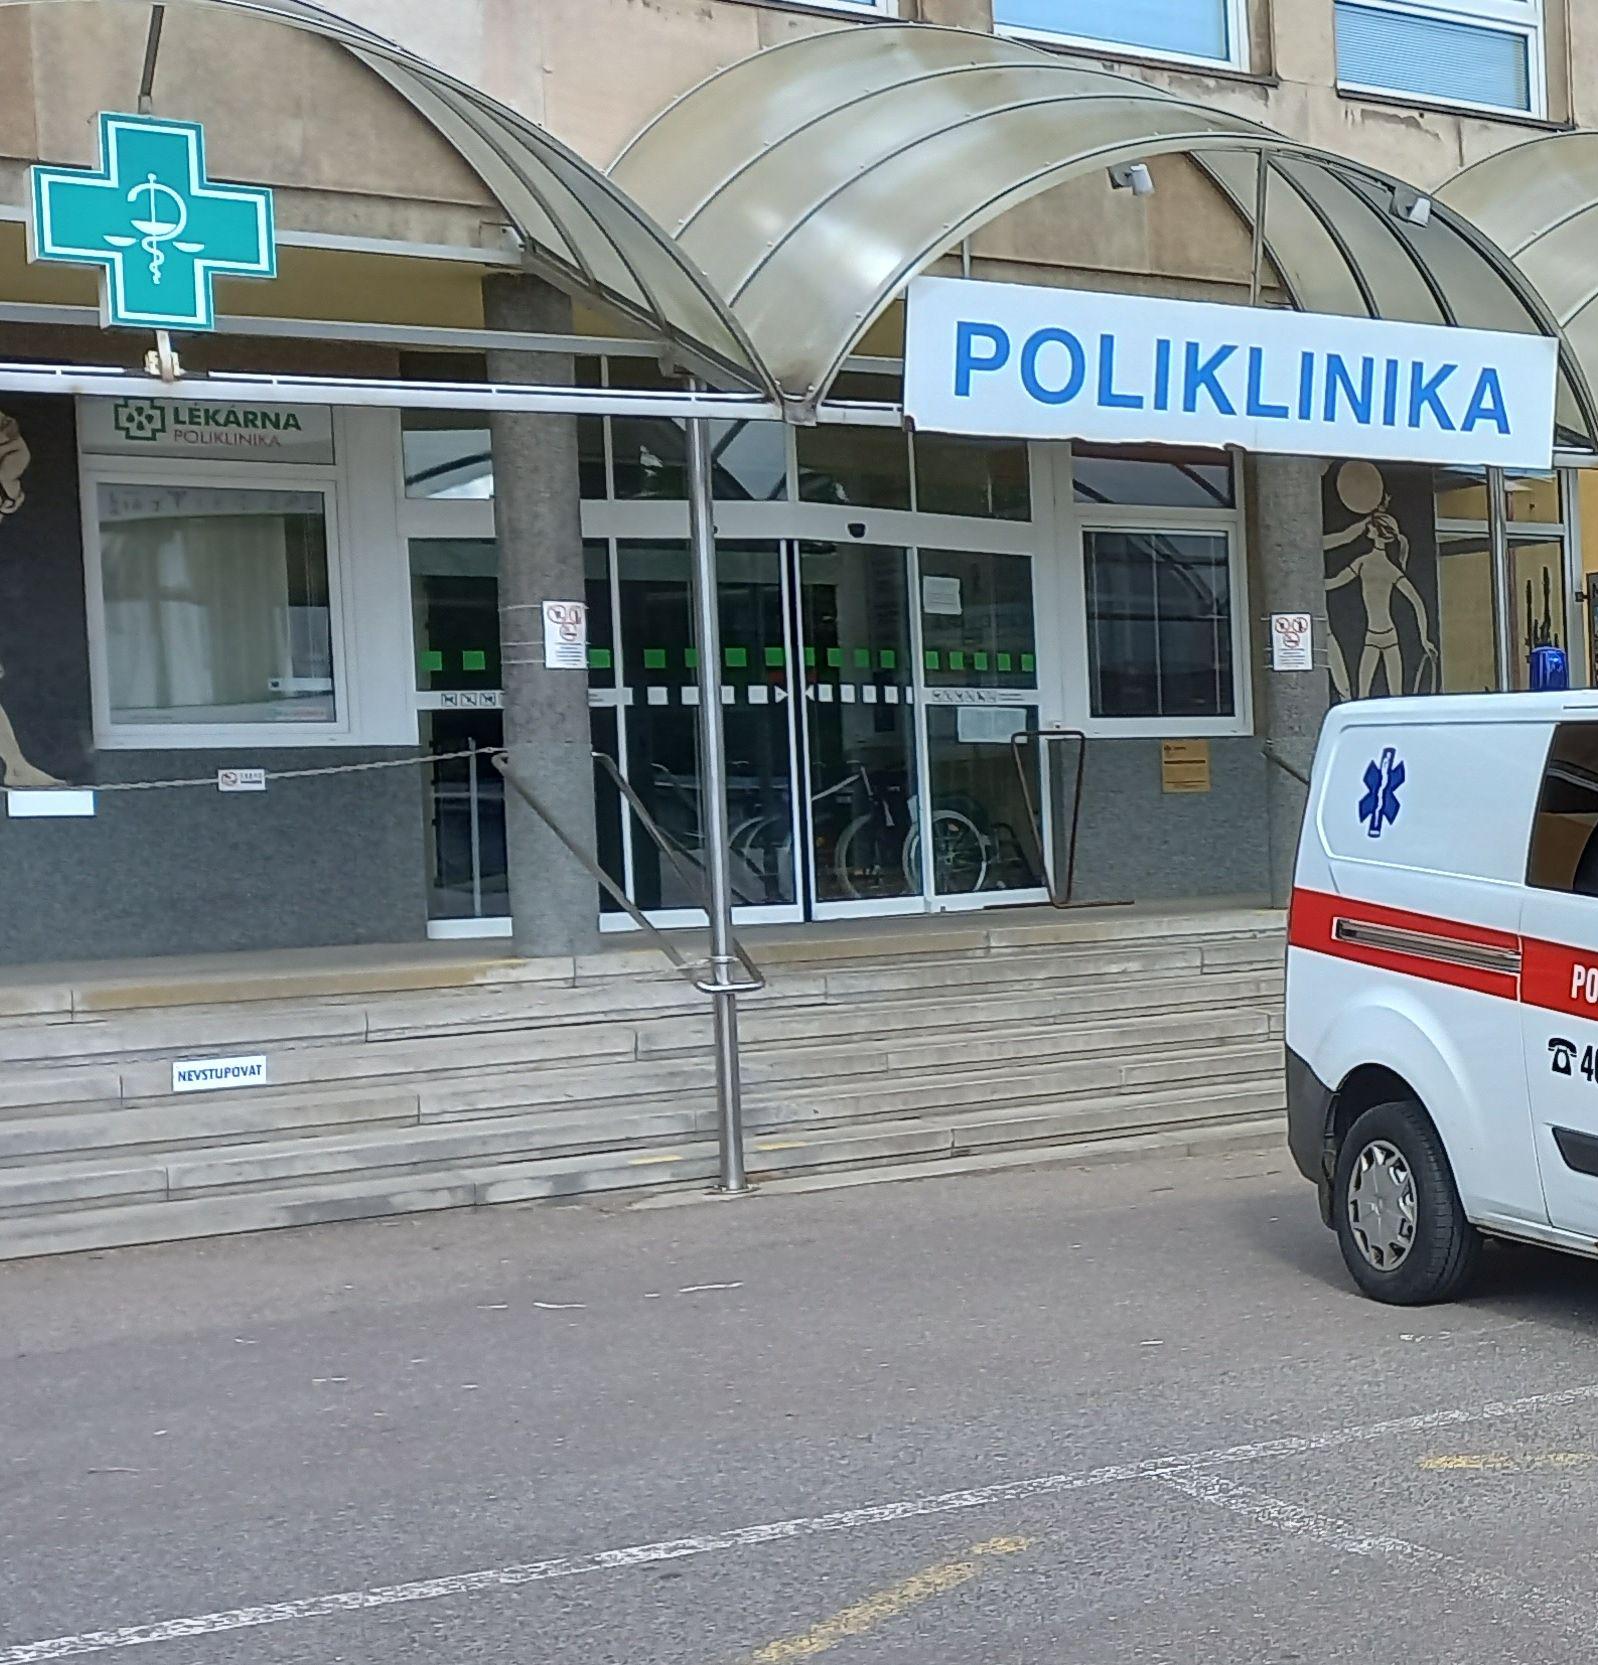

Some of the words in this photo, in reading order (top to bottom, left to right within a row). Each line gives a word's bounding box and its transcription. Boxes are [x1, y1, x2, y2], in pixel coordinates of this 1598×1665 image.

[954, 320, 1512, 435] POLIKLINIKA
[173, 402, 301, 431] LÉKÁRNA
[174, 429, 281, 448] POLIKLINIKA
[178, 1064, 262, 1082] NEVSTUPOVAT
